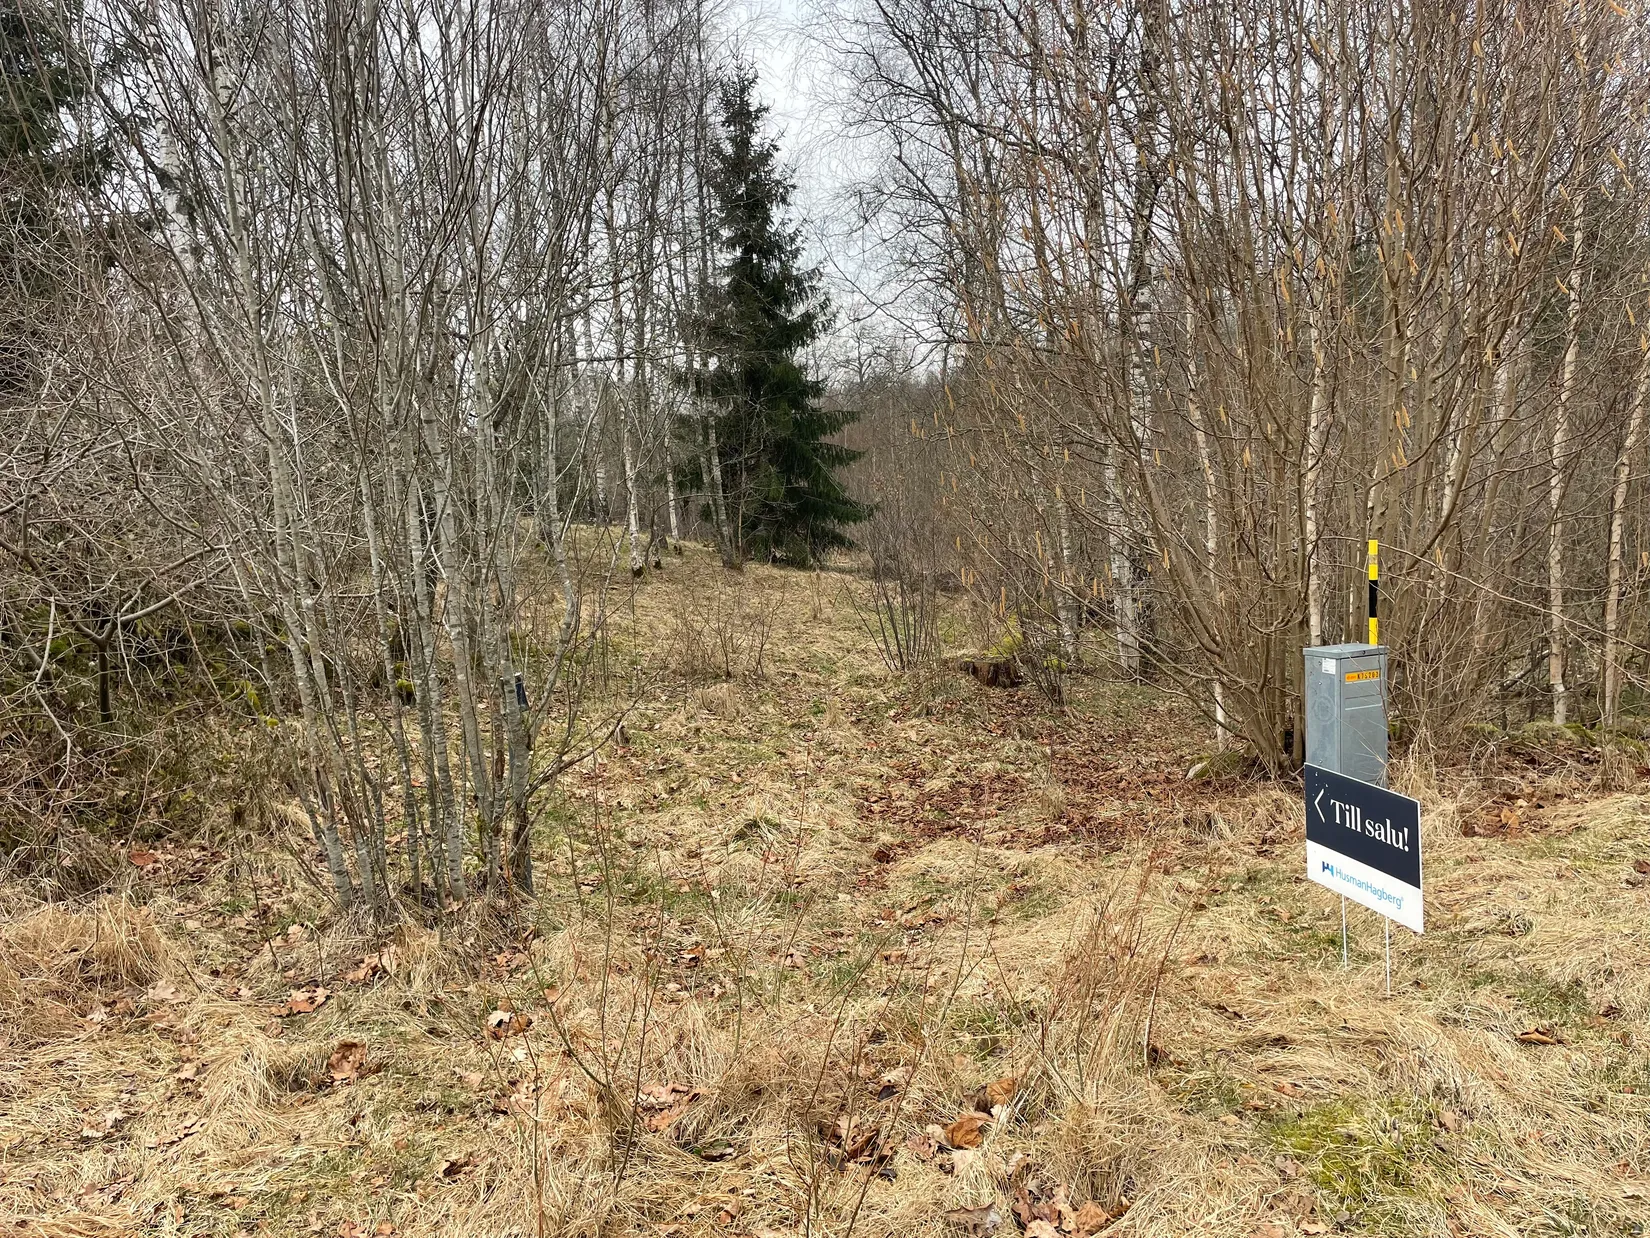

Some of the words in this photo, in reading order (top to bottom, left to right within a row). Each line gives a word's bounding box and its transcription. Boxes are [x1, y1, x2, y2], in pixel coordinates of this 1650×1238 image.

[1330, 799, 1361, 832] Till
[1365, 818, 1410, 852] salu!
[1335, 866, 1402, 910] HusmanHagberg
